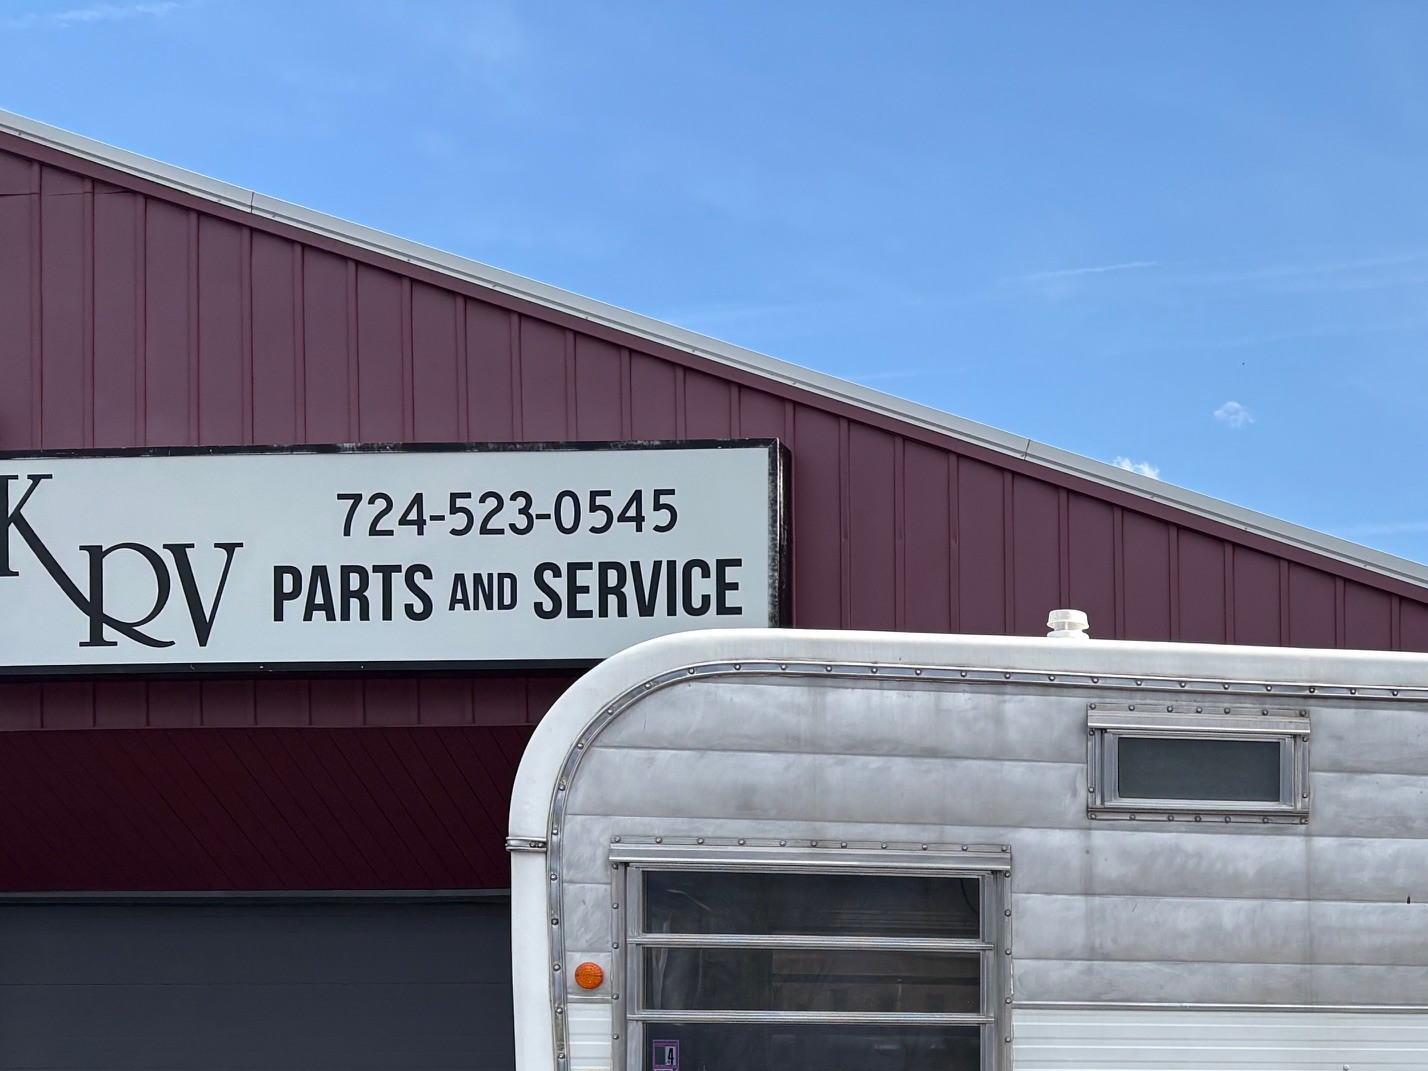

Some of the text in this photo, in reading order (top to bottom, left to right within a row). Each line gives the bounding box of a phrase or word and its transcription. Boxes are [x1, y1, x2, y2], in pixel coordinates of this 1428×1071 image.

[336, 488, 679, 537] 724-523-0545
[273, 558, 743, 622] PARTS AND SERVICE
